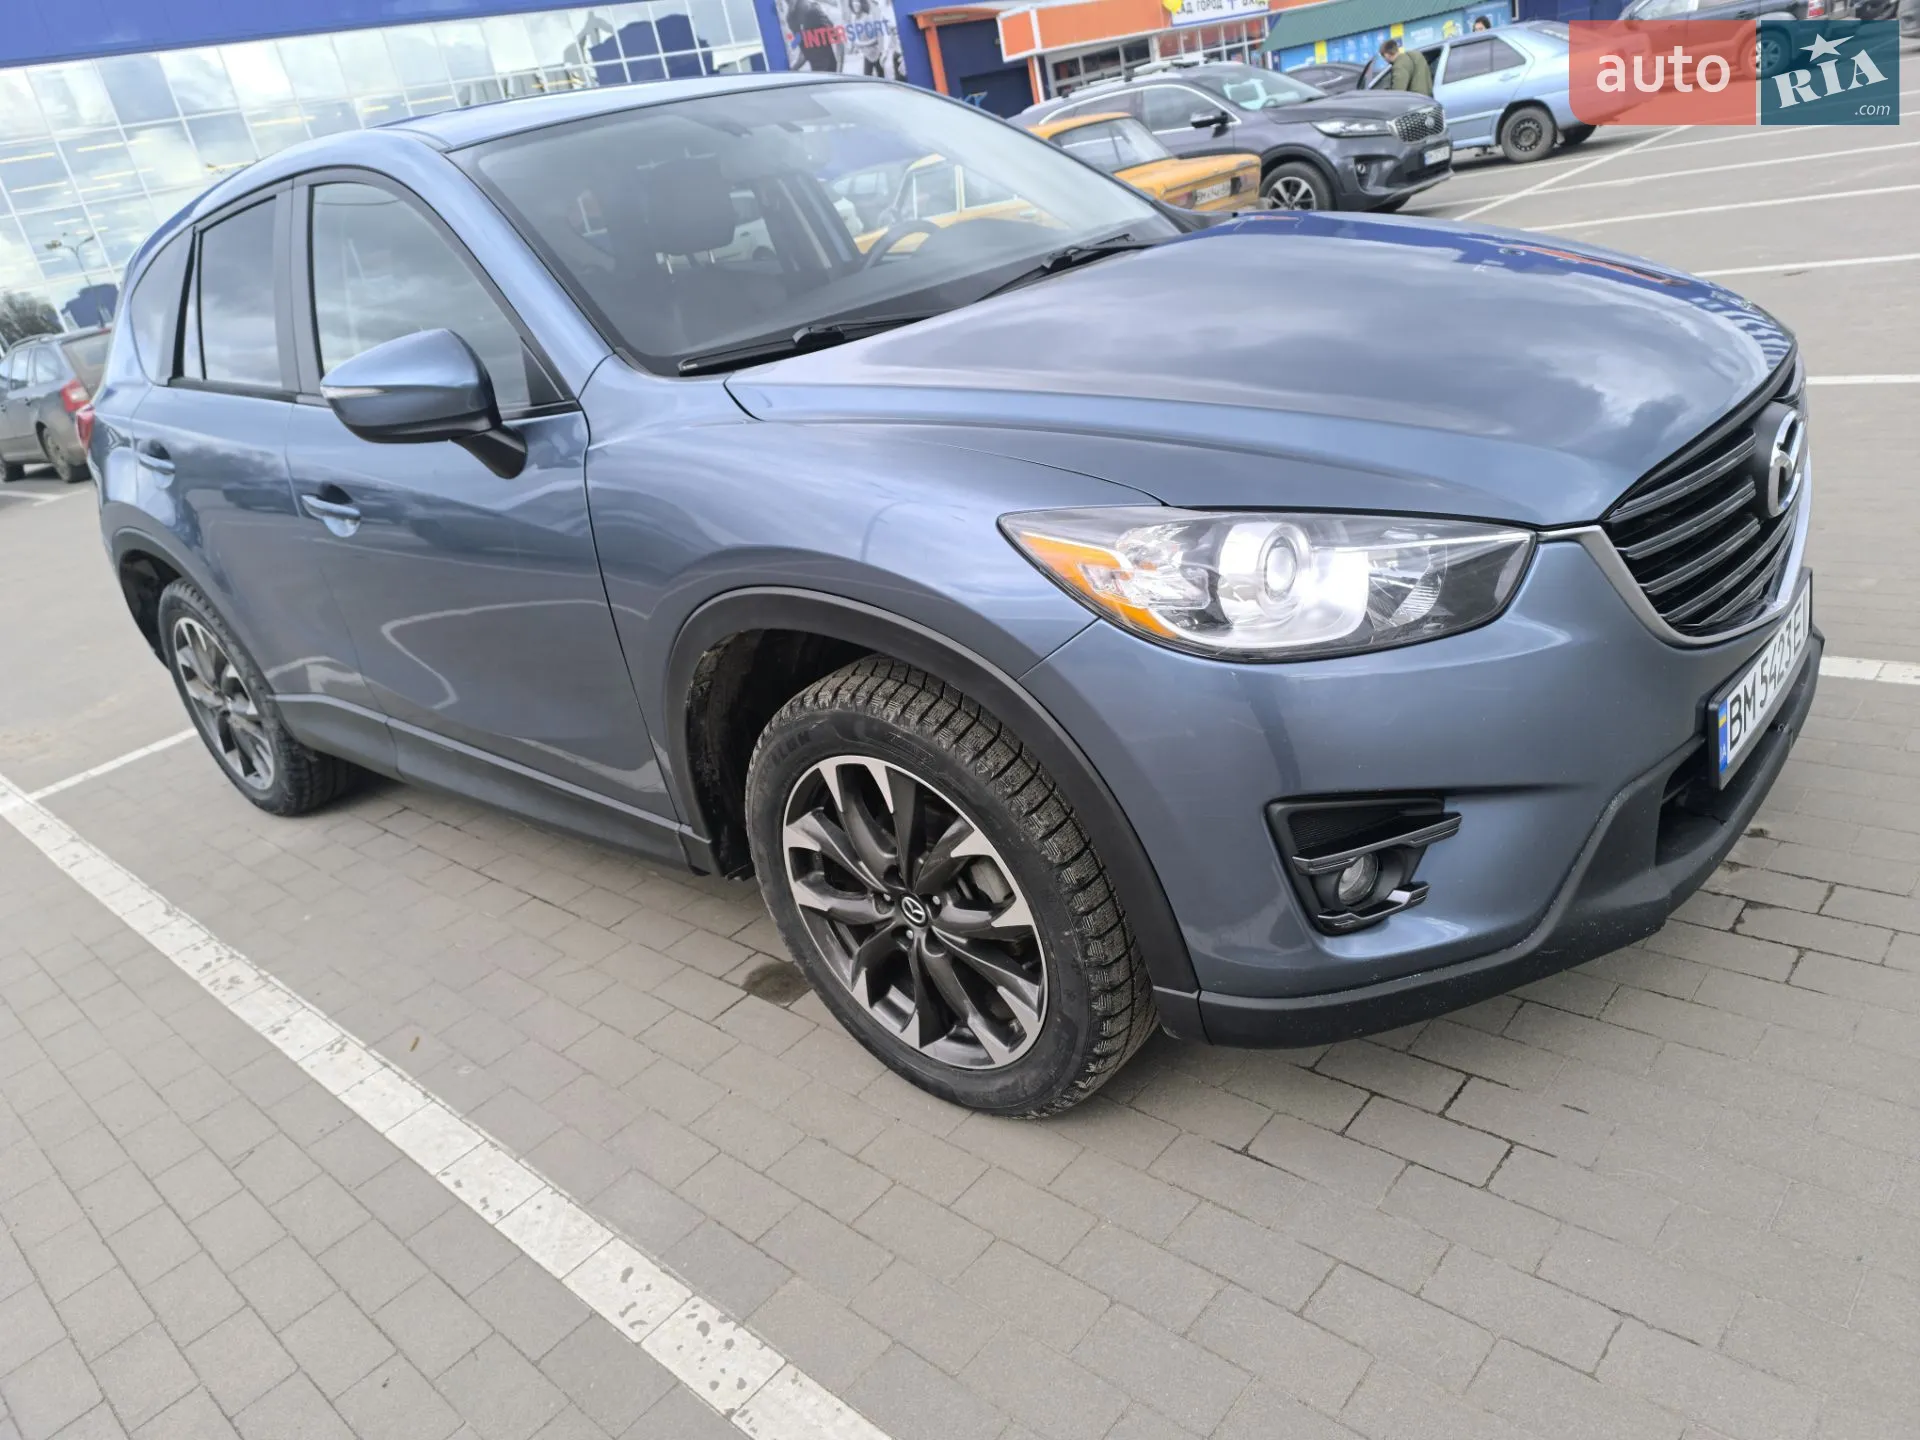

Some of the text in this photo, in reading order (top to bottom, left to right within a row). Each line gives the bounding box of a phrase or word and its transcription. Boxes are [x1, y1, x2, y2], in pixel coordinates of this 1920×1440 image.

[802, 19, 890, 48] INTERSPORT
[1729, 671, 1757, 751] BM
[1759, 618, 1792, 709] 5423
